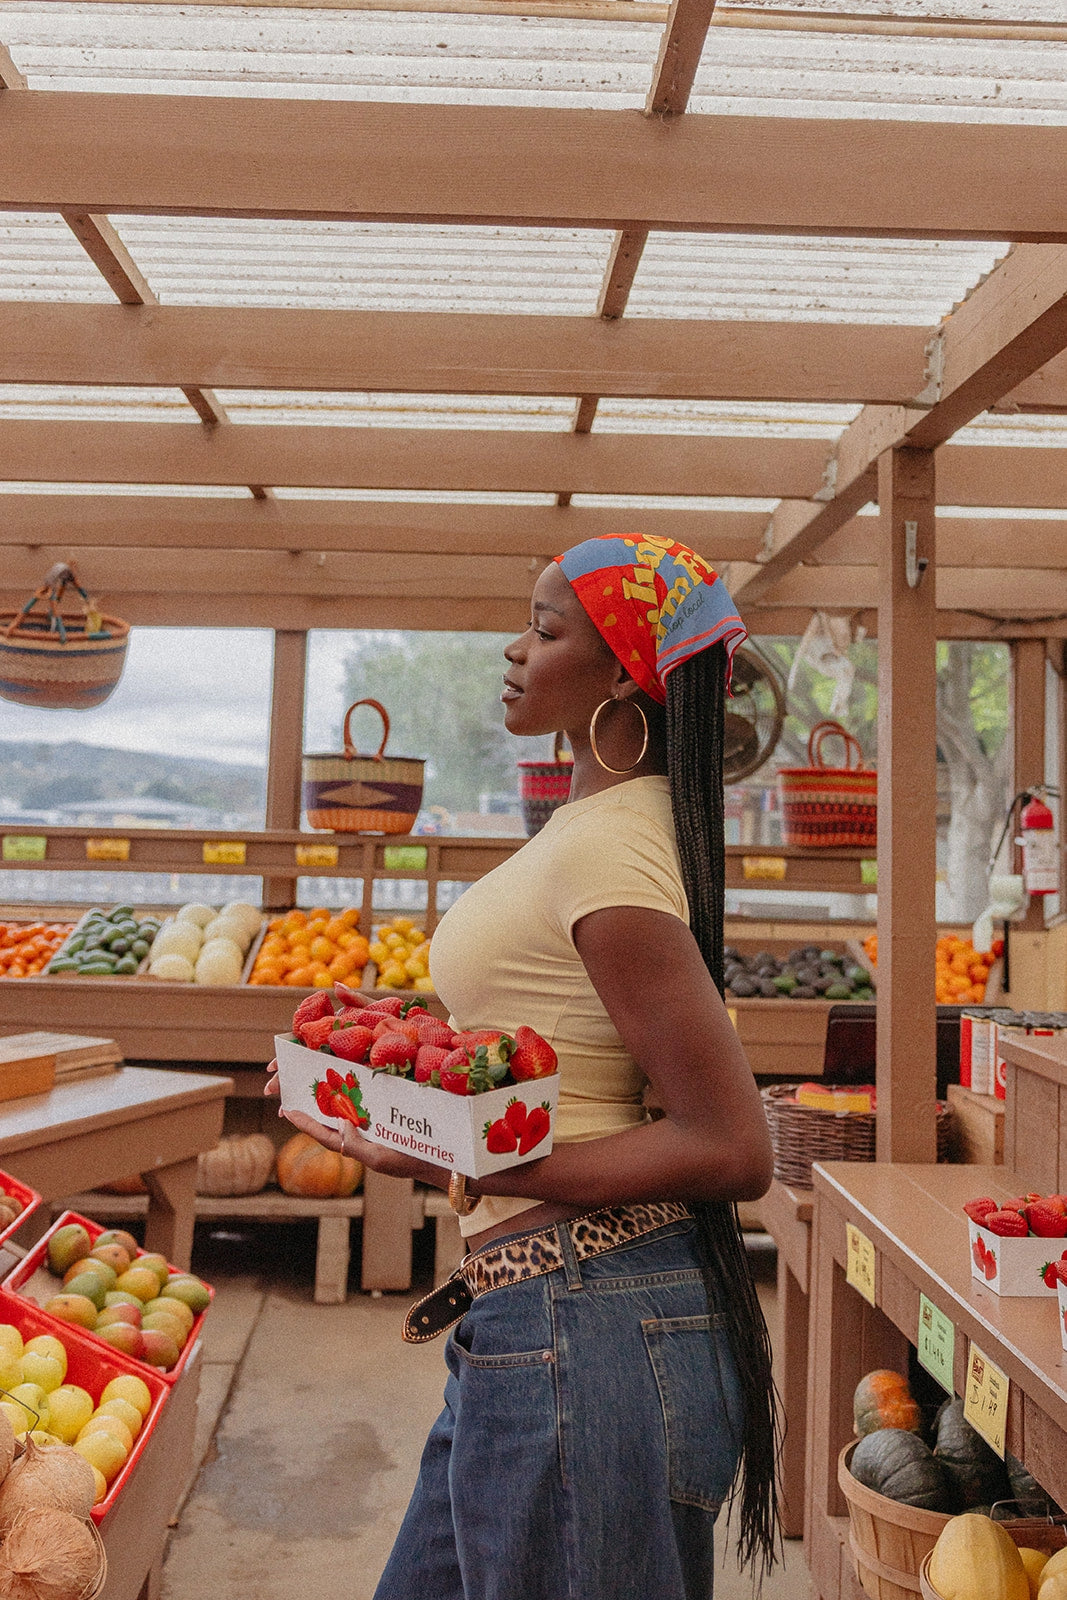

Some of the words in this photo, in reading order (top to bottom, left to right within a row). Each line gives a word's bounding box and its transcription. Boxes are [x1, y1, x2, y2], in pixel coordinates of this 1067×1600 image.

[682, 591, 705, 619] local
[390, 1106, 433, 1138] Fresh
[374, 1122, 455, 1163] Strawberries
